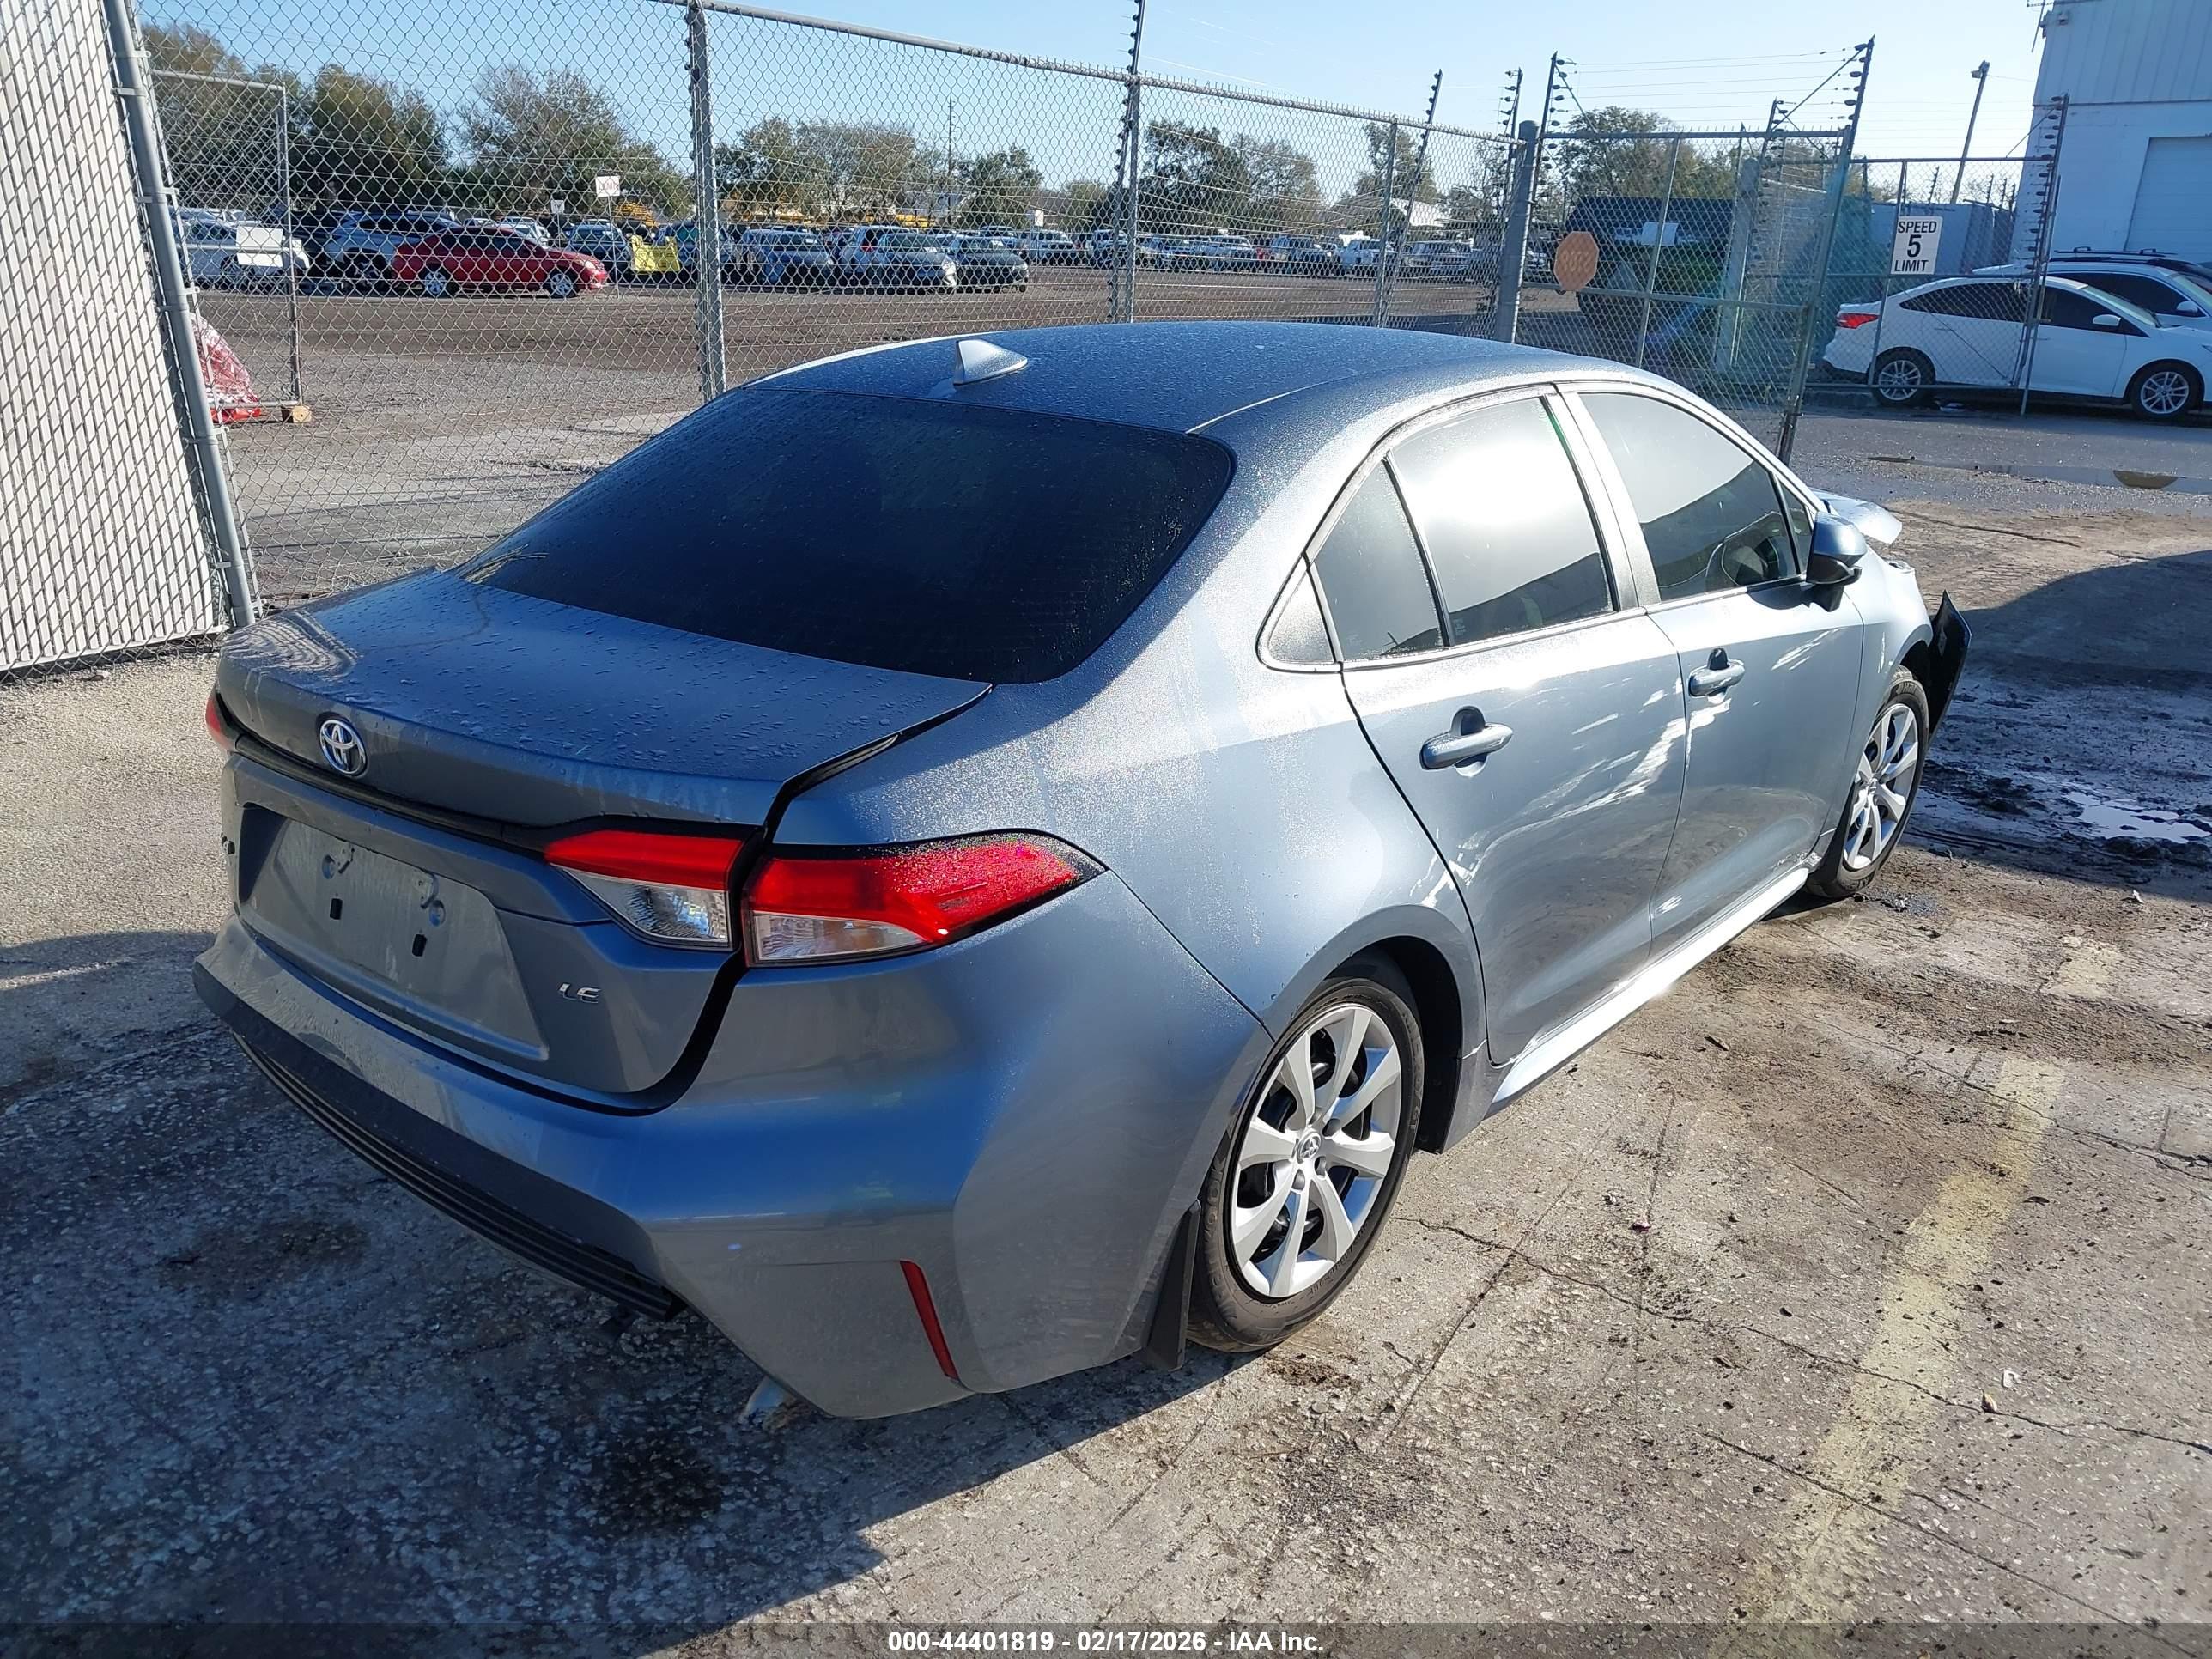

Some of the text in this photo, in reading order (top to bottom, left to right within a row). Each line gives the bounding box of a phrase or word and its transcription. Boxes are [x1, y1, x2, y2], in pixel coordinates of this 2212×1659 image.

[1898, 221, 1937, 234] SPEED
[1907, 234, 1922, 258] 5
[1894, 259, 1929, 272] LIMIT
[559, 983, 601, 1004] LE
